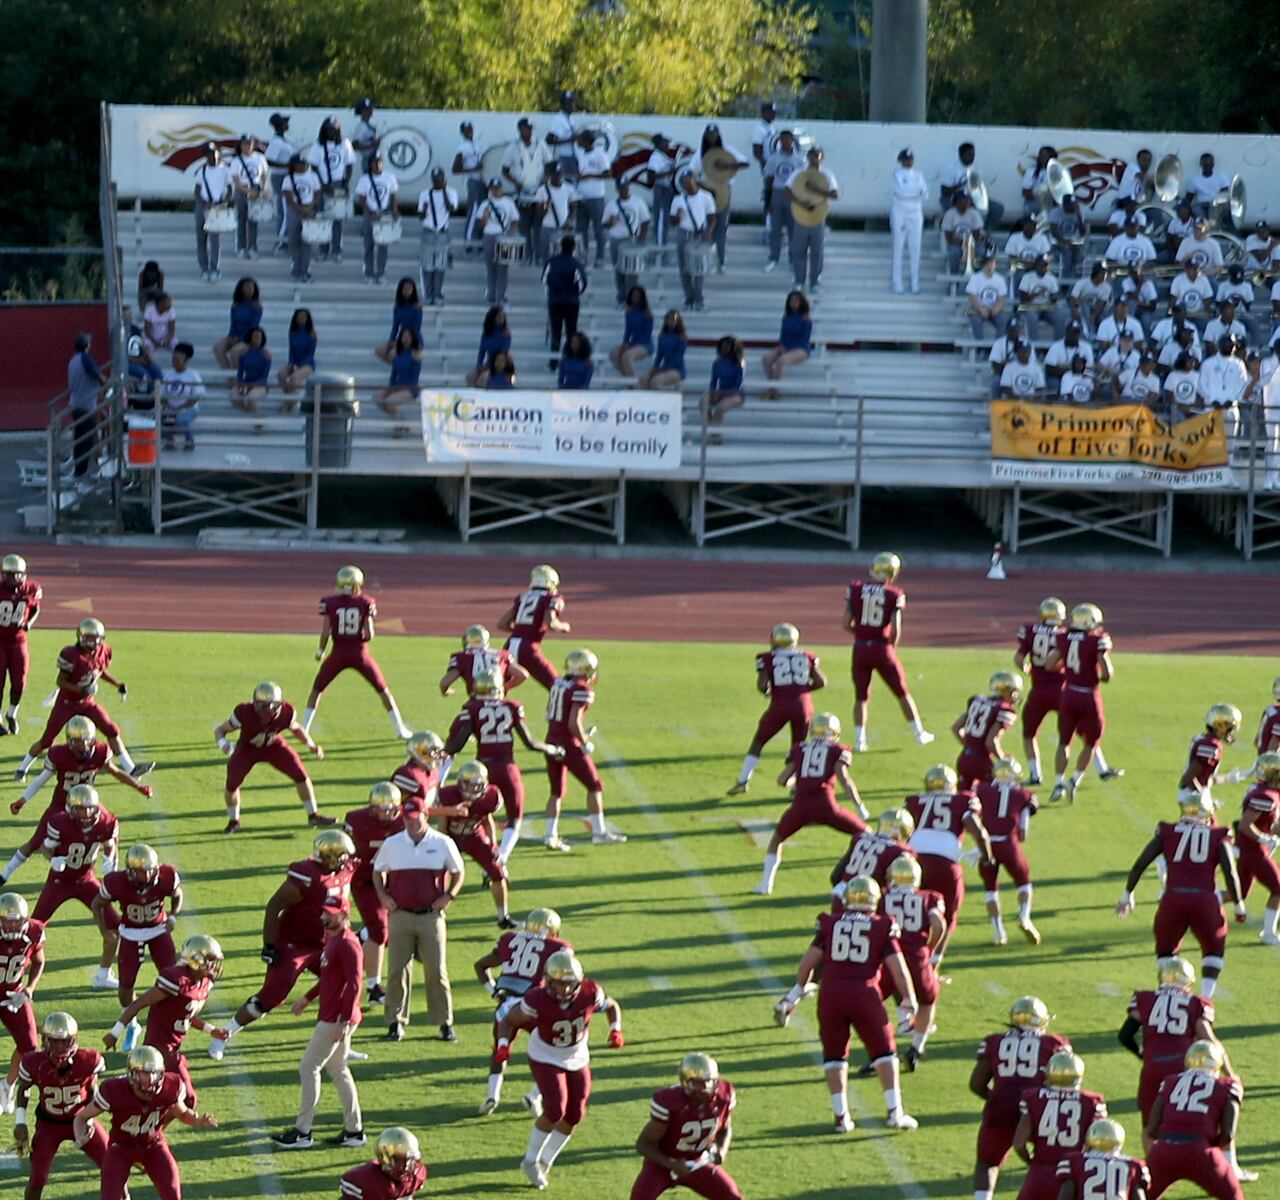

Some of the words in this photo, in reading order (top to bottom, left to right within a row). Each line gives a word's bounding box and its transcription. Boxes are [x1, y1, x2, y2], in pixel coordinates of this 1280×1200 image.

[452, 398, 543, 423] Cannon
[473, 423, 543, 436] CHURCH
[578, 405, 609, 423] the
[615, 406, 670, 427] place
[1040, 410, 1147, 434] Primrose
[555, 434, 574, 452] to
[580, 435, 605, 453] be
[611, 436, 669, 459] family
[1037, 437, 1061, 456] of
[1069, 437, 1120, 459] Five
[336, 606, 360, 636] 19
[478, 700, 514, 744] 22
[800, 740, 833, 779] 19
[917, 793, 952, 831] 75
[1172, 823, 1211, 864] 70
[884, 889, 922, 933] 59
[503, 938, 545, 978] 36
[831, 919, 873, 963] 65
[1147, 992, 1192, 1036] 45
[997, 1035, 1041, 1079] 99
[42, 1084, 82, 1116] 25
[1169, 1074, 1216, 1115] 42
[120, 1110, 161, 1136] 44
[675, 1117, 719, 1153] 27
[1038, 1098, 1081, 1147] 43
